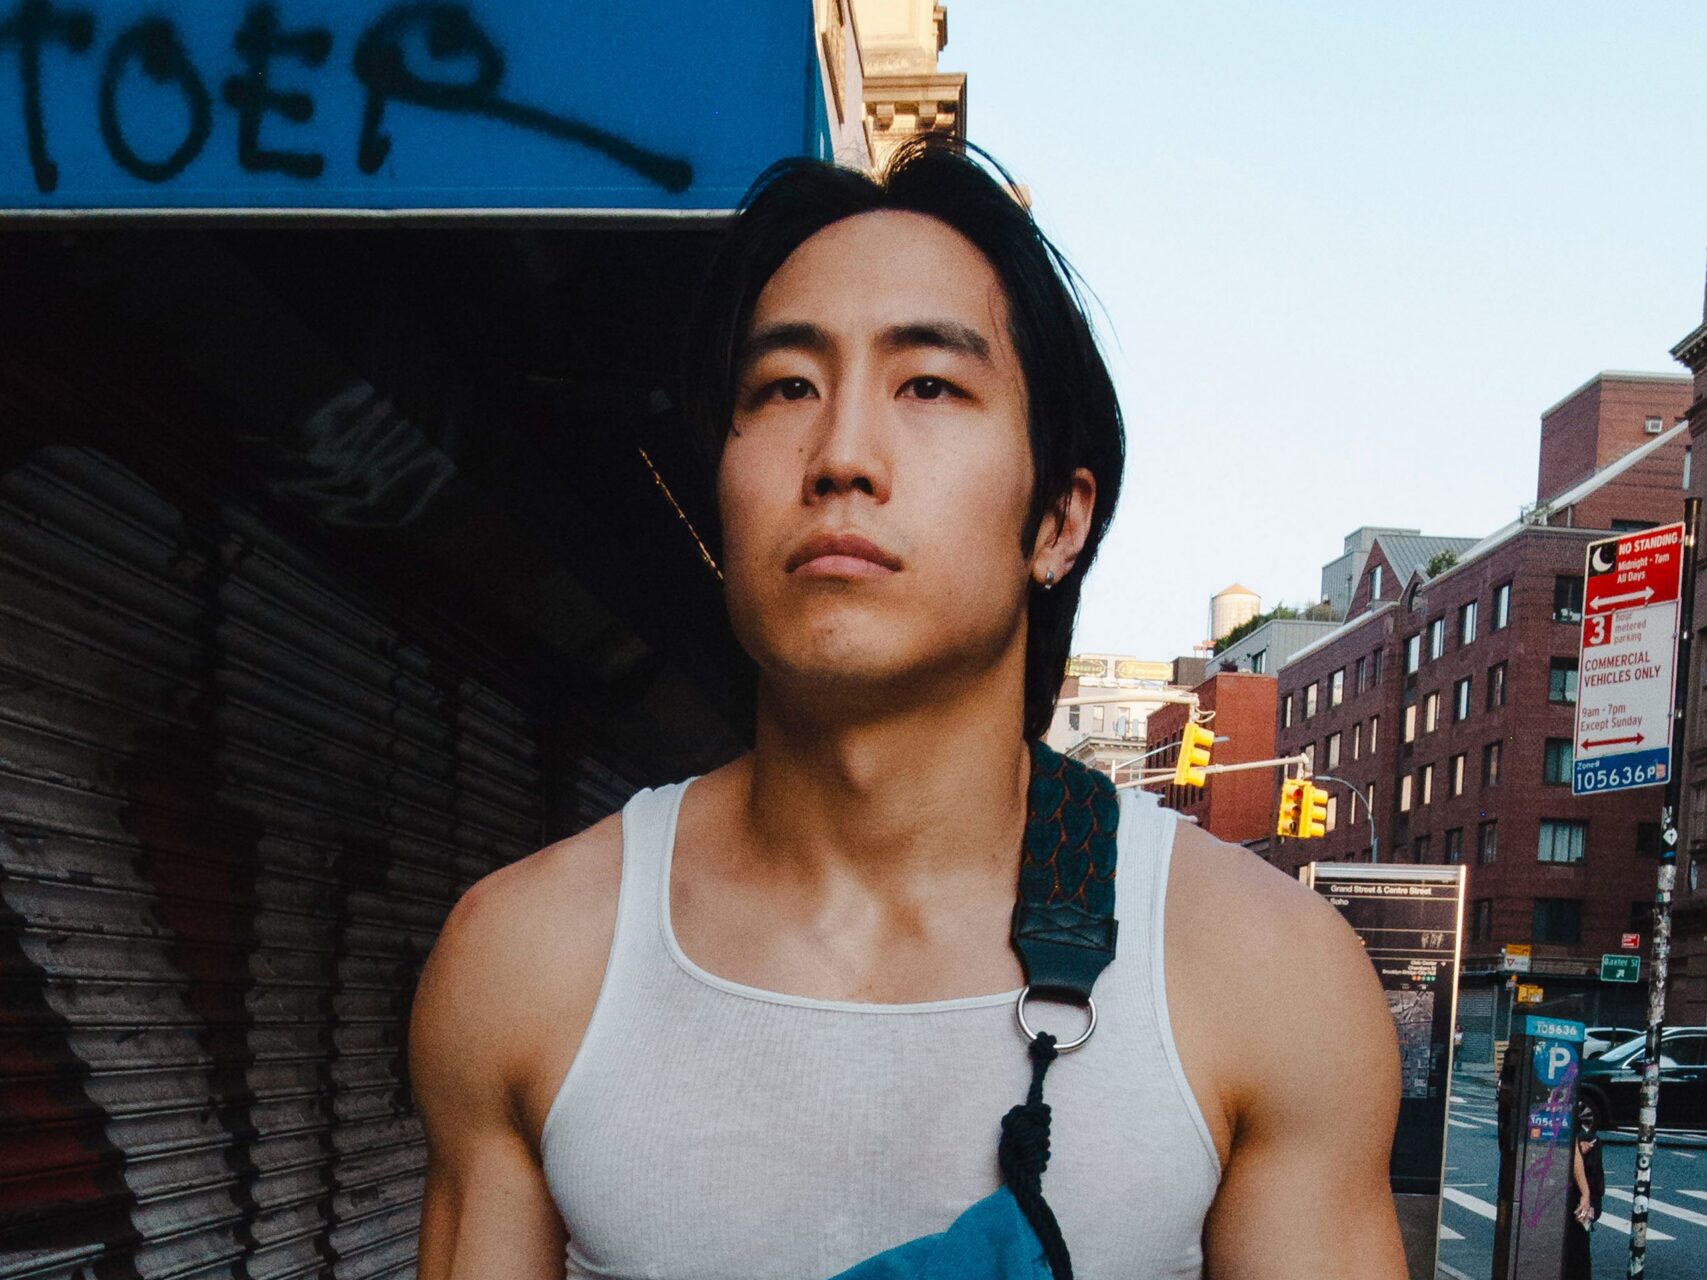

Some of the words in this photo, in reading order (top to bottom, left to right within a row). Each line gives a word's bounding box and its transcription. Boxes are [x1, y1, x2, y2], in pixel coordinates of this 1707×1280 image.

[1618, 543, 1632, 556] NO
[1634, 532, 1678, 552] STANDING
[1618, 557, 1648, 571] Midnight
[1654, 553, 1670, 564] 7am
[1616, 574, 1627, 584] All
[1628, 571, 1646, 582] Days
[1589, 616, 1605, 644] 3
[1615, 619, 1647, 633] metered
[1614, 633, 1642, 646] parking
[1585, 651, 1651, 672] COMMERCIAL
[1584, 669, 1632, 688] VEHICLES
[1634, 664, 1661, 681] ONLY
[1582, 707, 1600, 717] 9am
[1608, 703, 1626, 715] 7pm
[1580, 719, 1609, 732] Except
[1611, 715, 1643, 729] Sunday
[1577, 765, 1645, 790] 105636
[1330, 885, 1353, 893] Grand
[1354, 885, 1376, 894] Street
[1384, 886, 1408, 895] Centre
[1409, 887, 1432, 895] Street
[1604, 957, 1628, 967] Baxter
[1536, 1021, 1577, 1036] 105636
[1548, 1047, 1571, 1079] P
